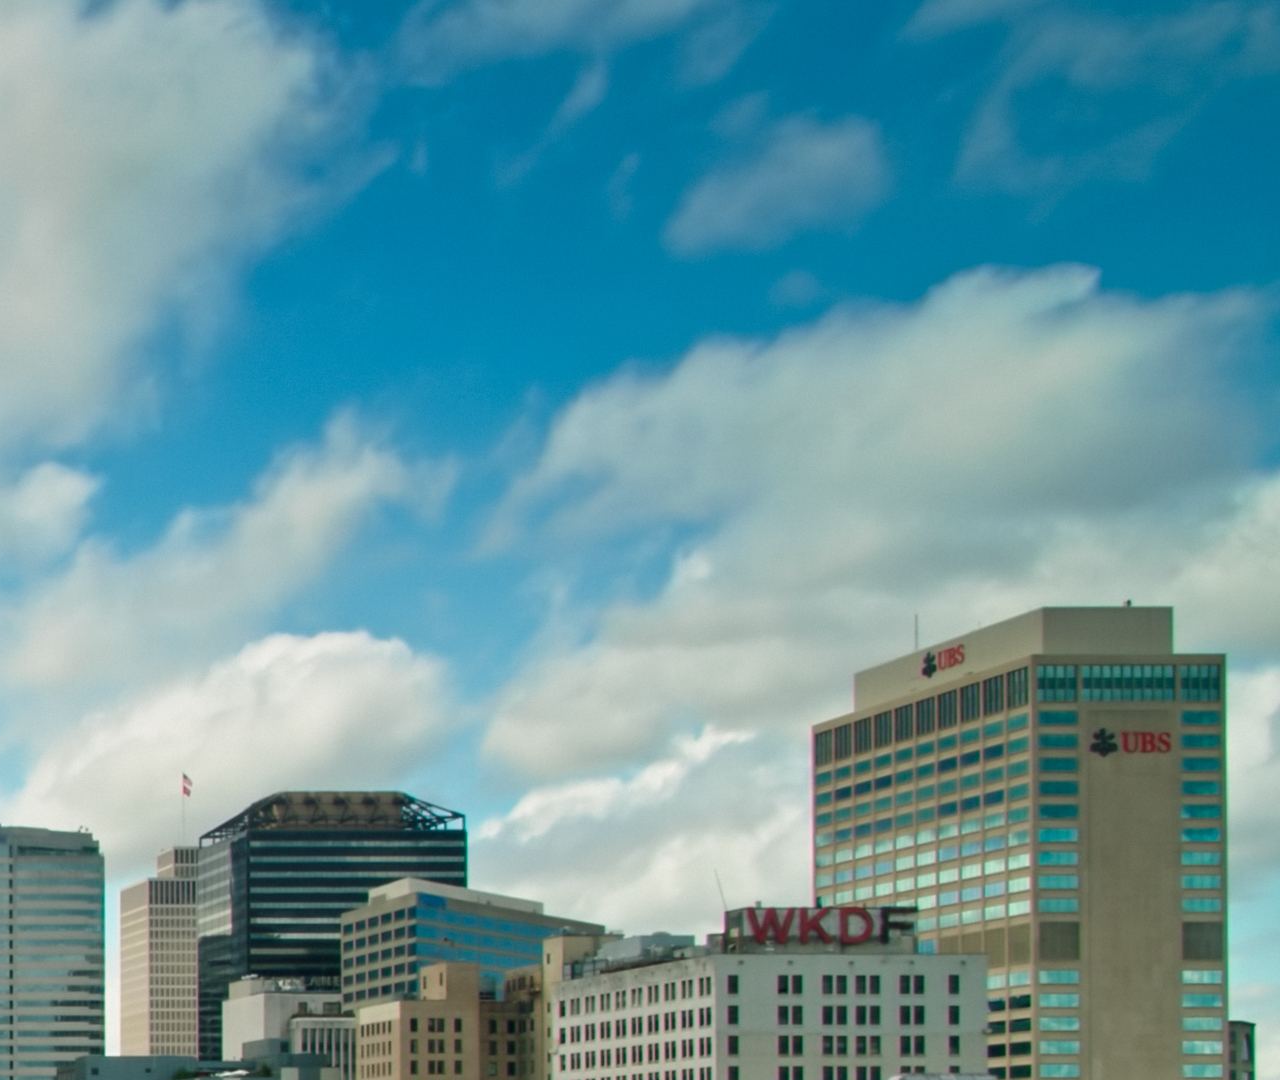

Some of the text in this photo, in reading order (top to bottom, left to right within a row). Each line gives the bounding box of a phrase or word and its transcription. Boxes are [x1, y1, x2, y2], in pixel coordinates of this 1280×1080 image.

[936, 644, 964, 671] UBS
[1121, 732, 1171, 753] UBS
[744, 906, 919, 945] WKDF
